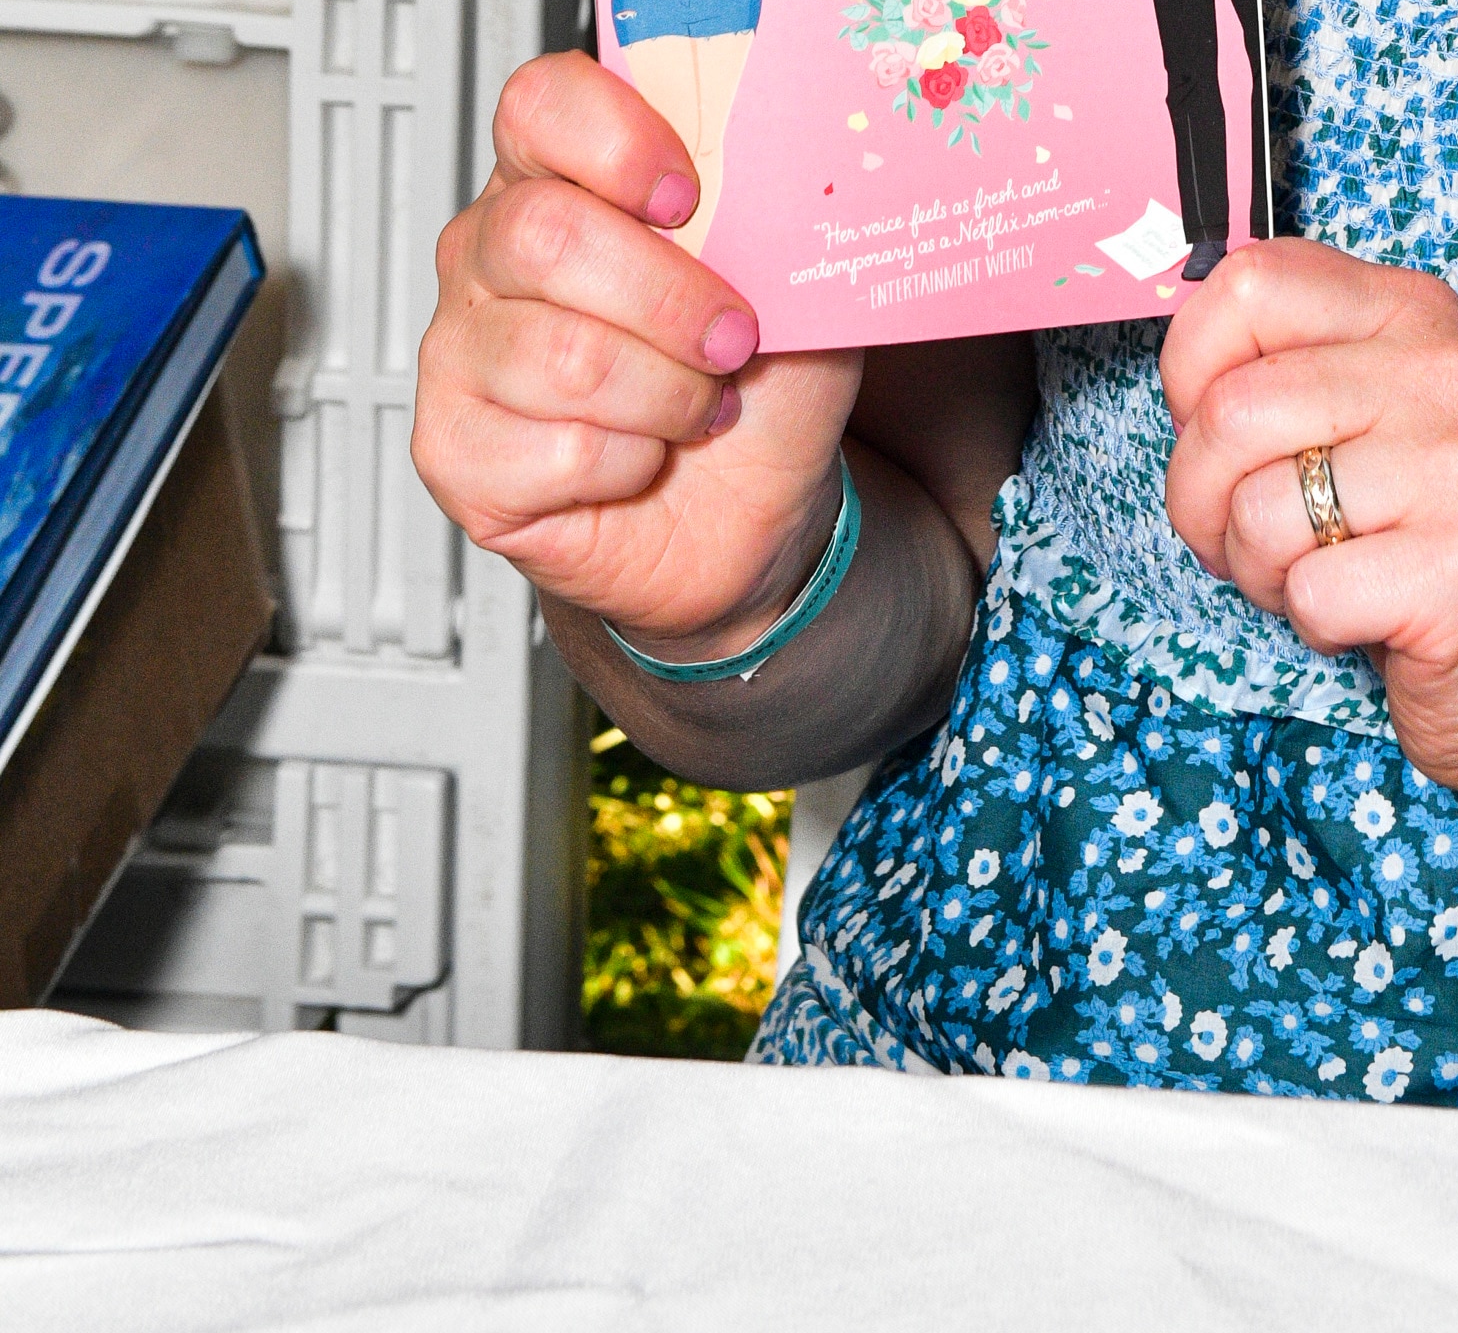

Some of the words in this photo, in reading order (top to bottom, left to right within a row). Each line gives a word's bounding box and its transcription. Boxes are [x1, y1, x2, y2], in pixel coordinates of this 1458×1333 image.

[861, 215, 906, 238] voice
[908, 199, 947, 238] feels
[951, 197, 970, 216] as
[972, 179, 1019, 219] fresh
[1021, 168, 1062, 200] and
[789, 244, 915, 286] contemporary
[917, 238, 936, 255] as
[939, 236, 952, 249] a
[953, 213, 1021, 251] Netflix
[984, 243, 1036, 278] WEEKLY
